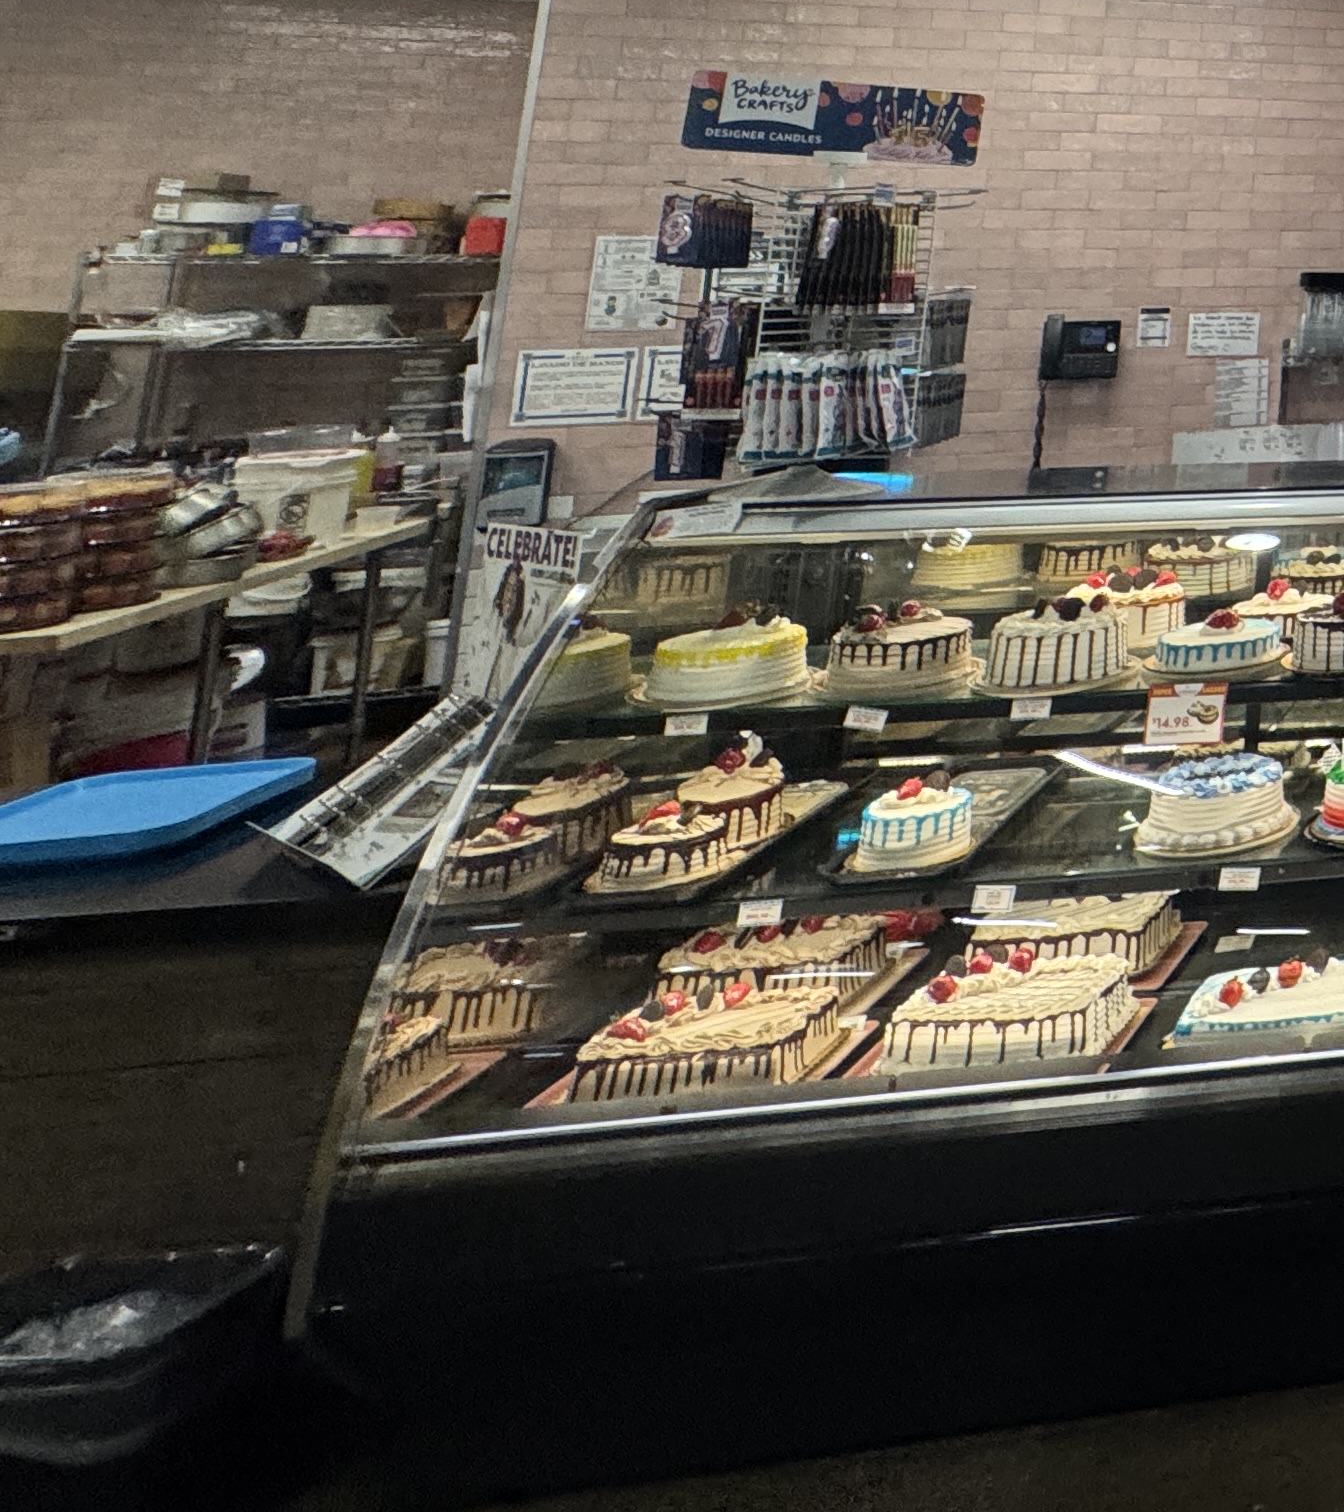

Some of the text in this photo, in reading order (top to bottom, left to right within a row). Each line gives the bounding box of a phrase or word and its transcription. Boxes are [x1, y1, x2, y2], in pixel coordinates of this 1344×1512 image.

[731, 79, 814, 111] Bakery
[737, 98, 795, 114] CRAFTS
[705, 127, 822, 145] DESIGNER CANDLES
[487, 527, 577, 569] CELEBRATE!
[1152, 716, 1189, 728] $14.98
